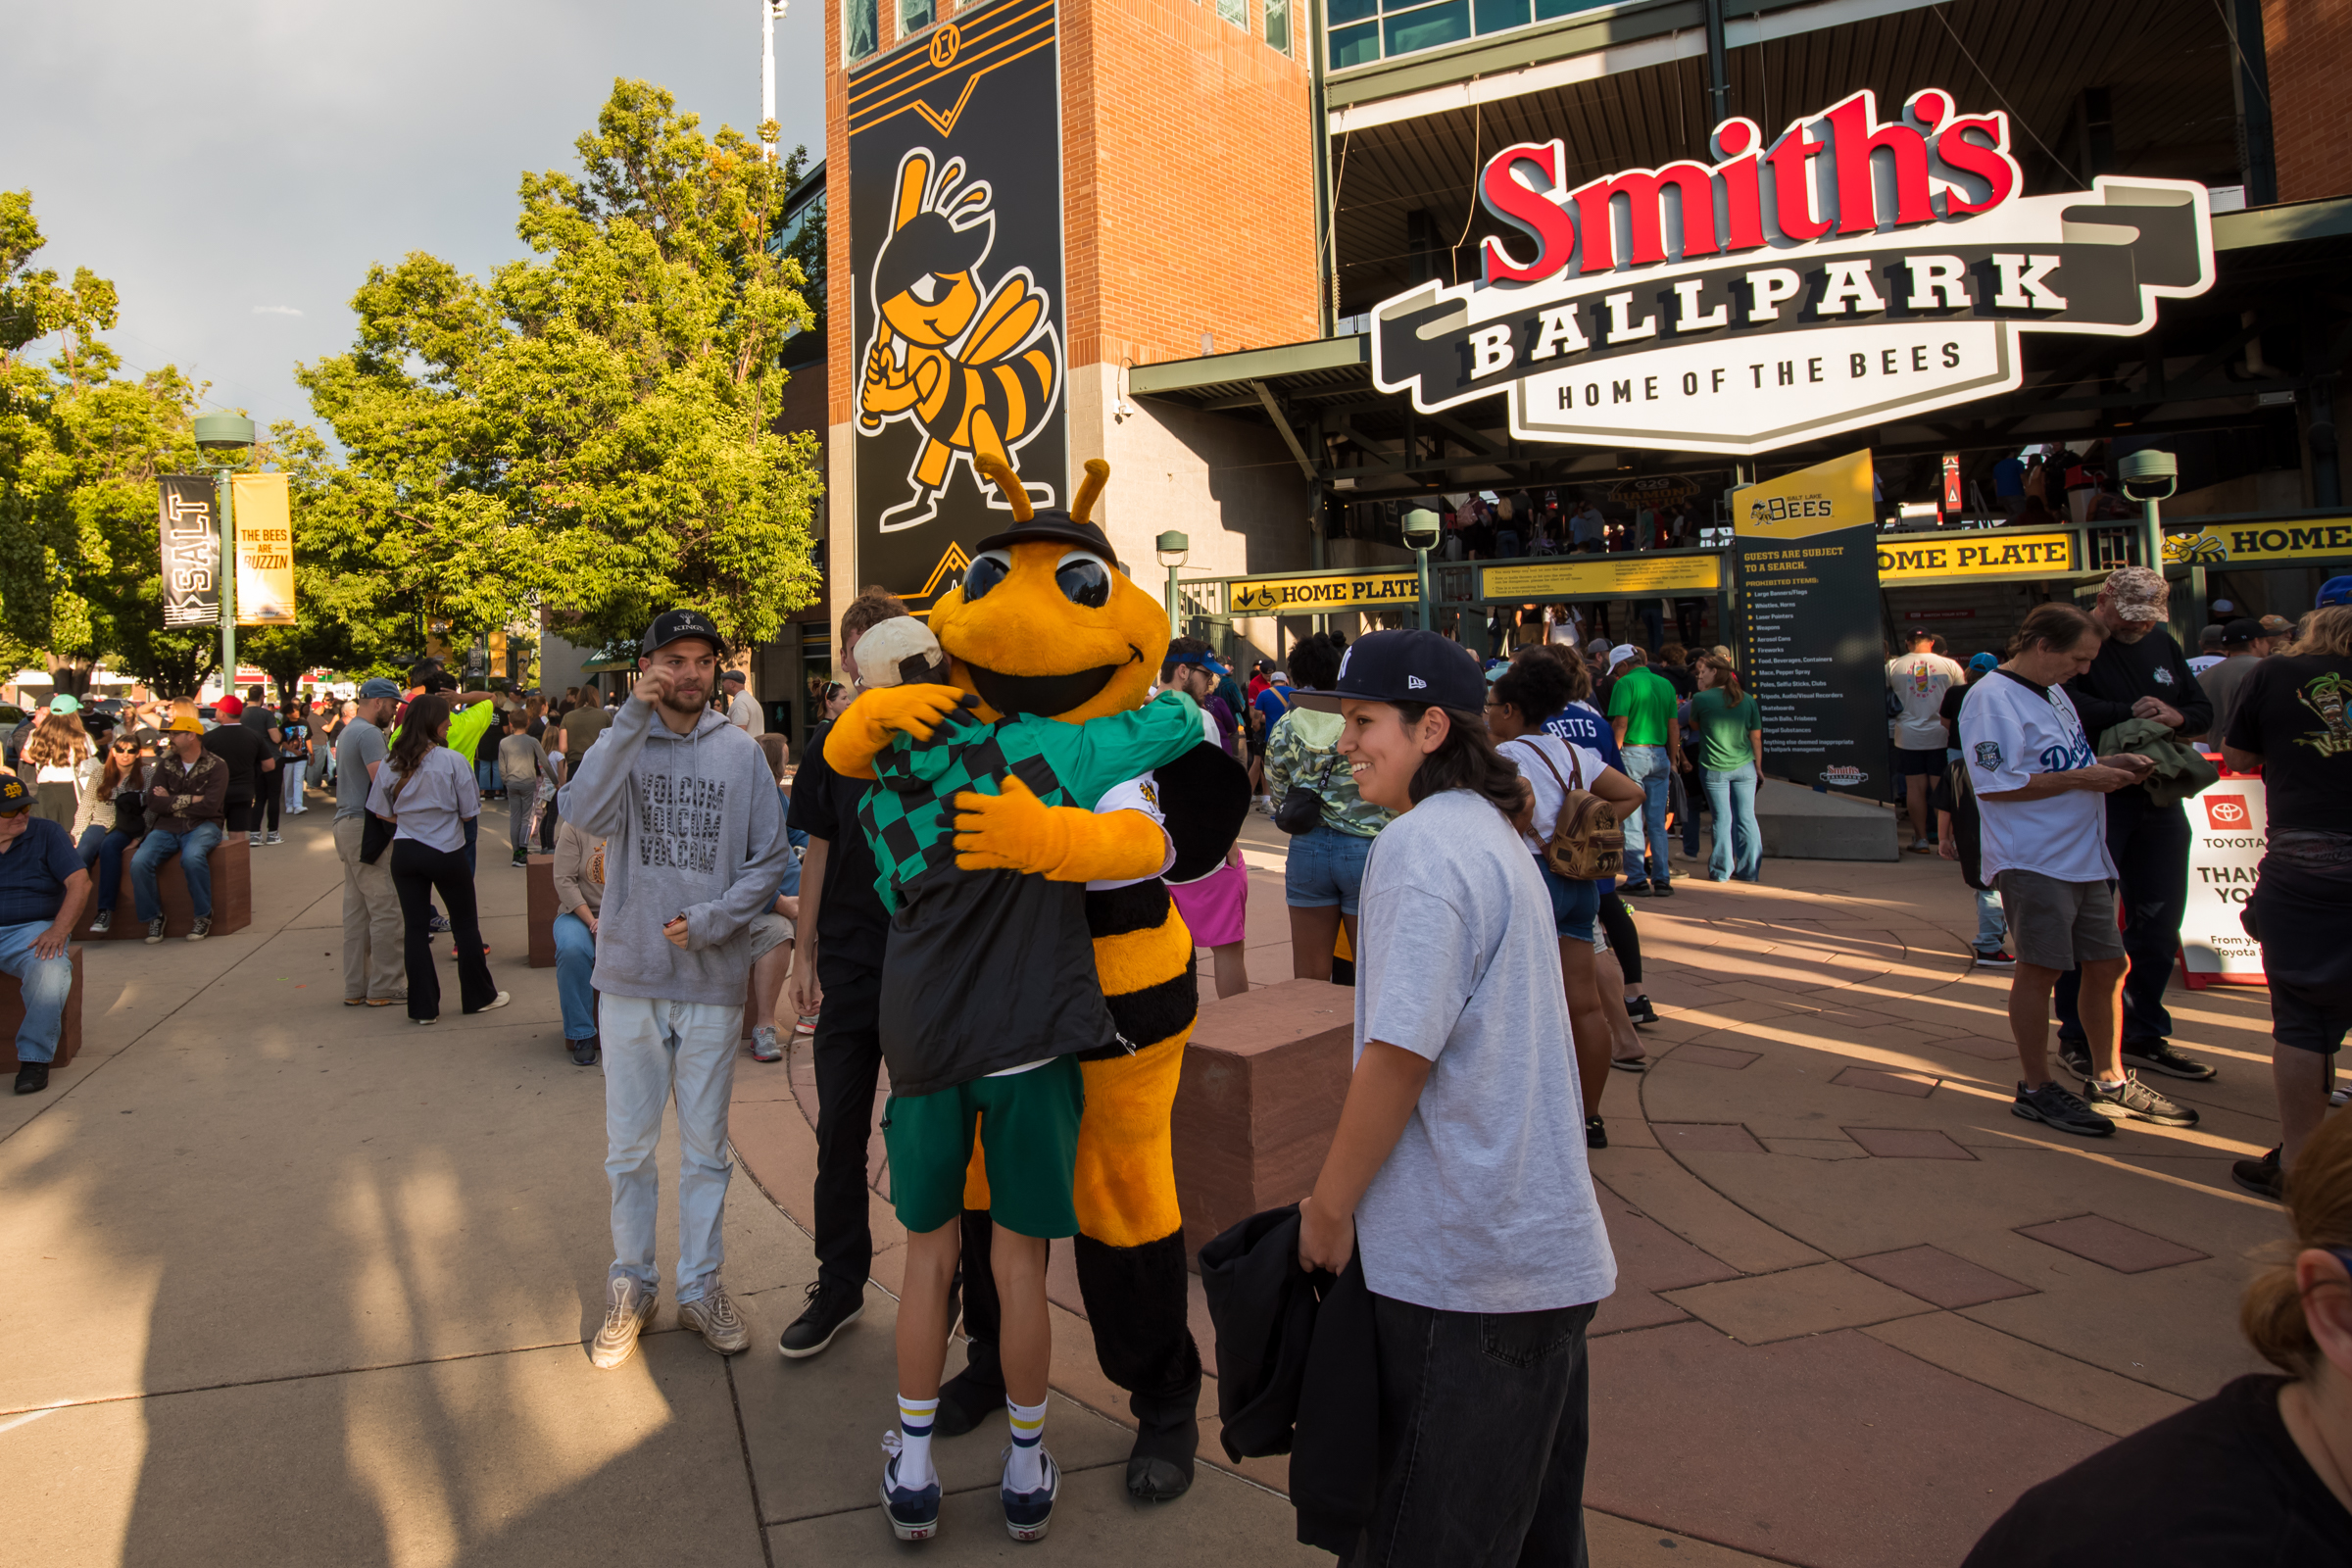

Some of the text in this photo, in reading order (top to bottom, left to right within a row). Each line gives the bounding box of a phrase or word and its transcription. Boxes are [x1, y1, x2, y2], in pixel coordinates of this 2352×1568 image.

[1483, 88, 2015, 285] Smith's
[1468, 253, 2069, 381] BALLPARK
[1556, 341, 1963, 411] HOME OF THE BEES
[1635, 478, 1670, 488] G2G
[1610, 486, 1698, 501] DIAMOND
[1767, 496, 1832, 521] BEES
[168, 493, 212, 592] SALT
[241, 529, 287, 541] THE BEES
[2230, 525, 2352, 553] HOME
[257, 544, 272, 554] ARE
[1744, 547, 1844, 562] GUESTS ARE SUBJECT
[1878, 541, 2067, 571] OME PLATE
[244, 555, 288, 569] BUZZIN
[1759, 564, 1765, 572] A
[1768, 561, 1807, 571] SEARCH.
[1282, 583, 1347, 603] HOME
[1545, 718, 1597, 739] BETTS
[1827, 764, 1859, 775] Smith's
[641, 773, 726, 812] VOLCOM
[640, 802, 722, 845] VOLCOM
[2203, 838, 2266, 849] TOYOTA
[639, 835, 718, 875] VOLCOM
[2197, 866, 2261, 883] THAN
[2214, 887, 2256, 904] YO
[2210, 935, 2242, 945] From
[2215, 947, 2256, 958] Toyota
